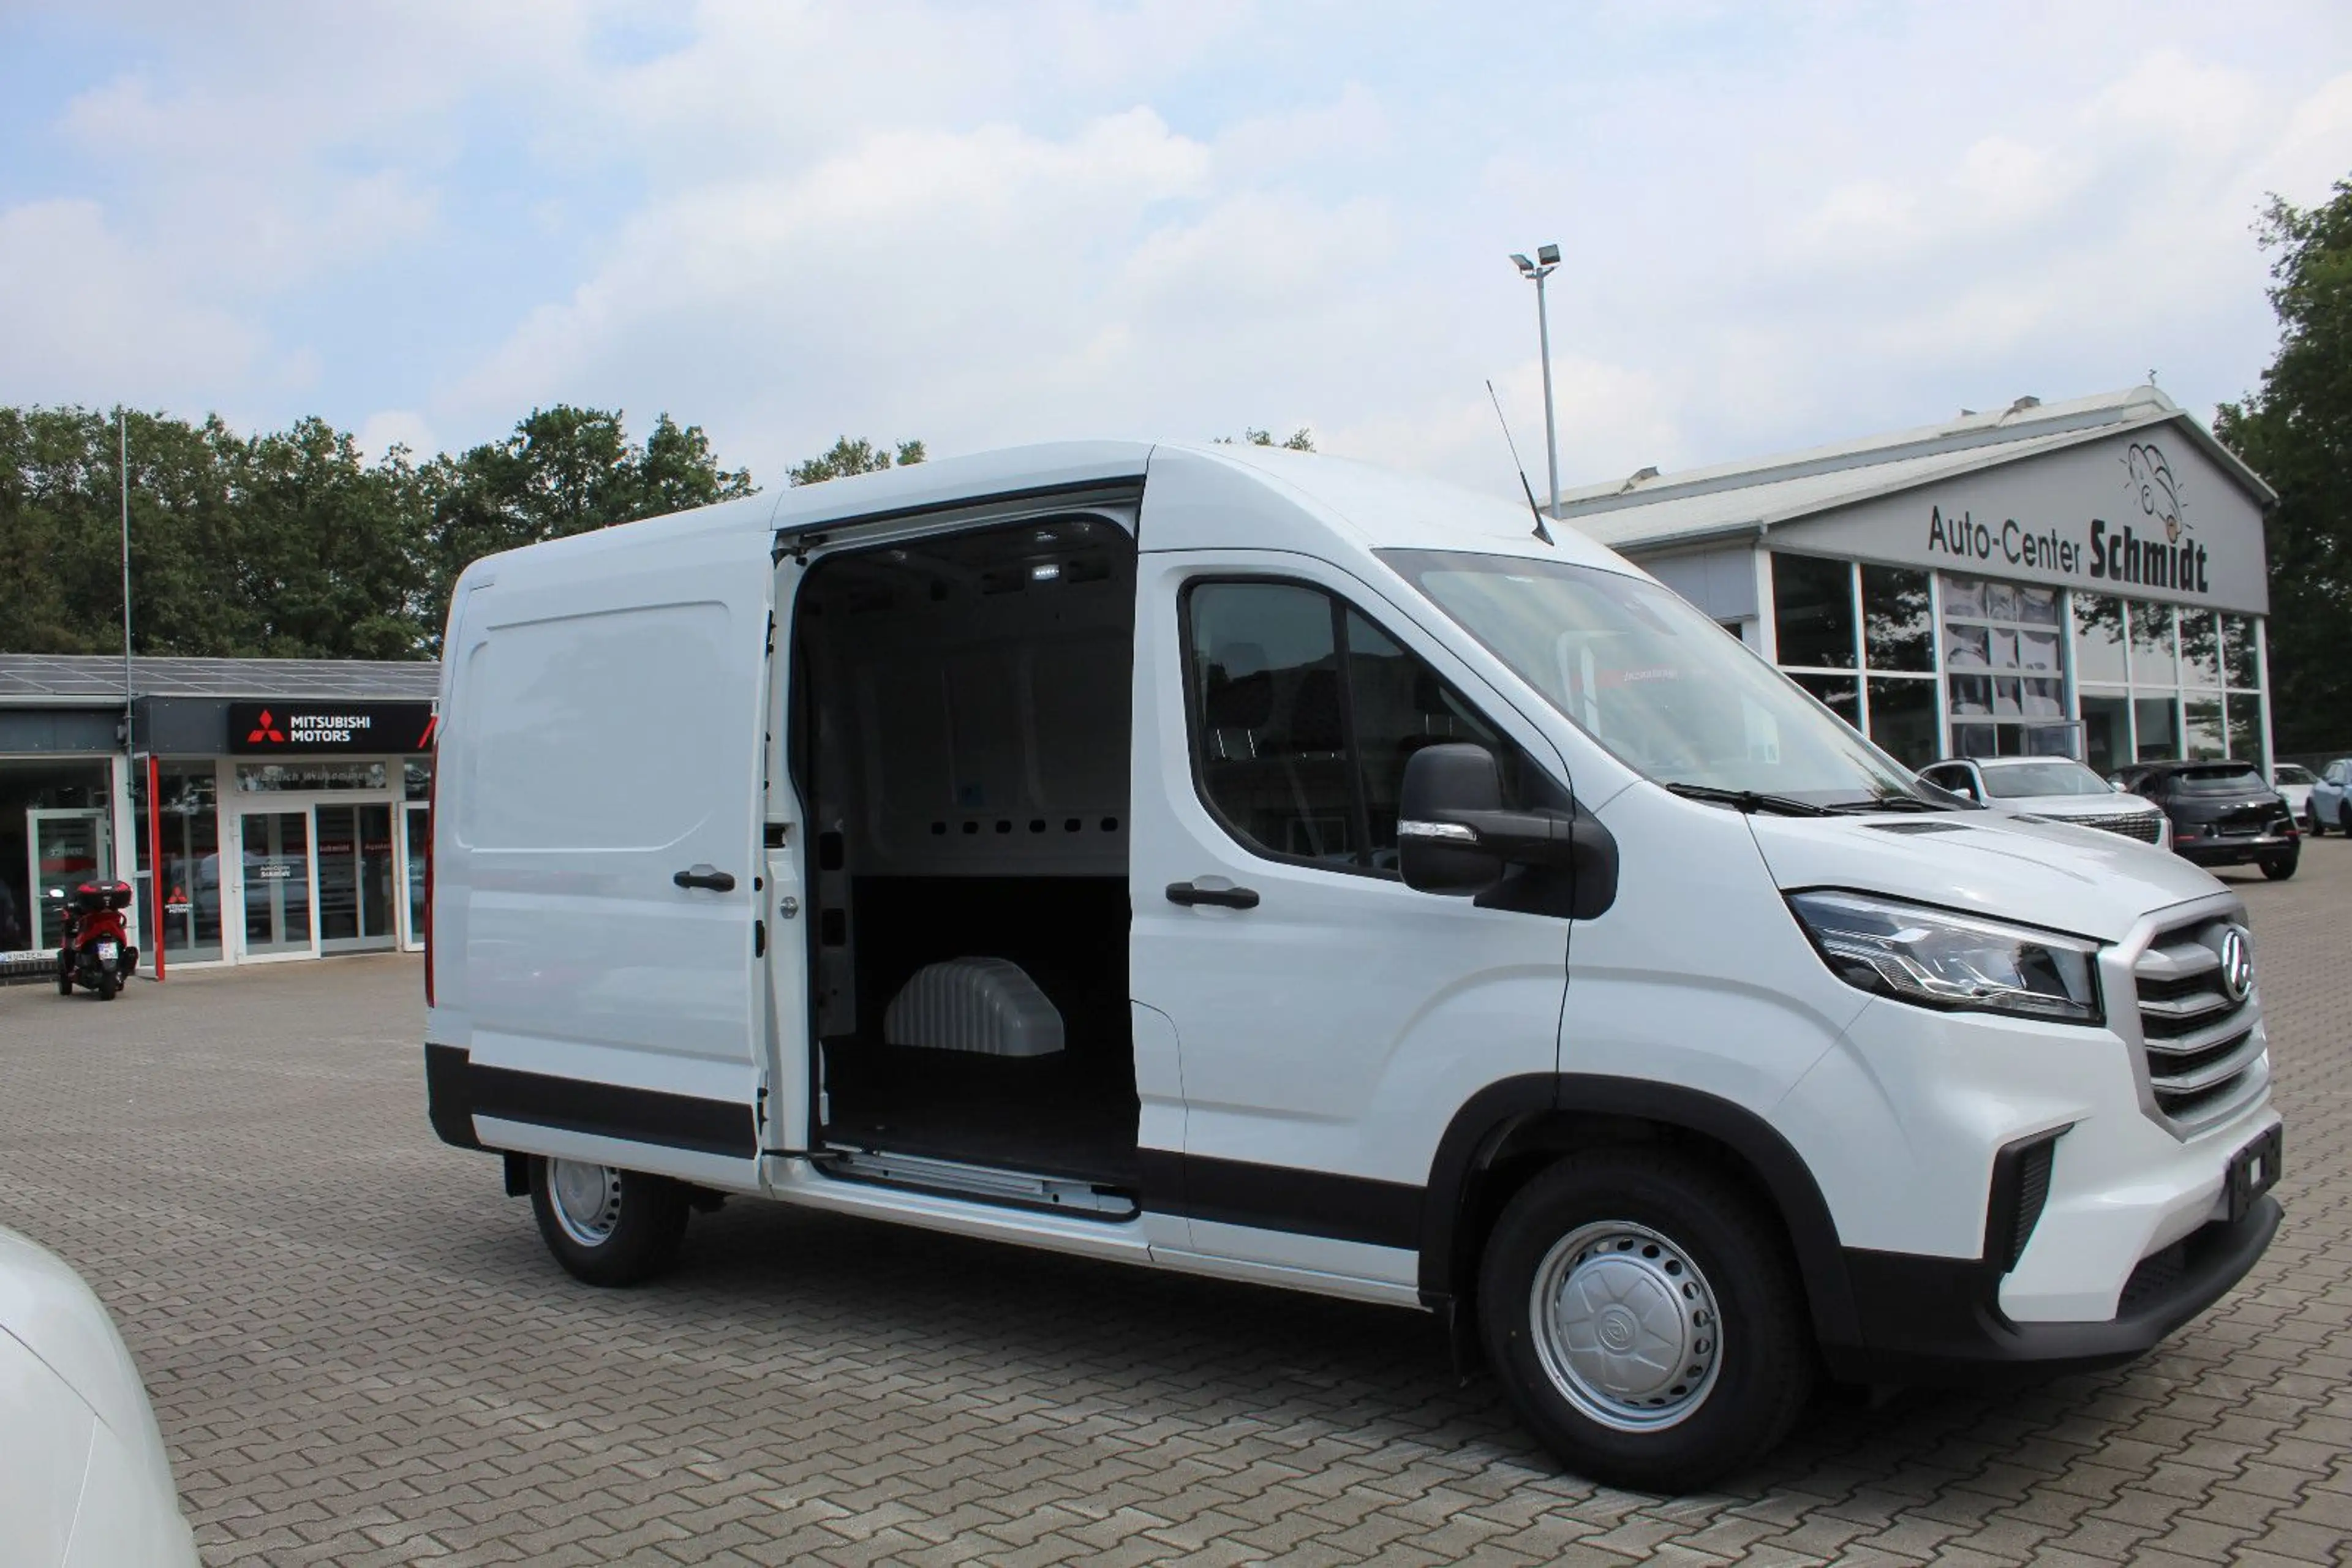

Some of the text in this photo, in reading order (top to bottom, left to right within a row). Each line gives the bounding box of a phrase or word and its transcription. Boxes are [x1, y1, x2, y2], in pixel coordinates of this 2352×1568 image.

[1929, 505, 2209, 593] Auto-Center Schmidt
[290, 715, 370, 728] MITSUBISHI
[291, 729, 350, 742] MOTORS
